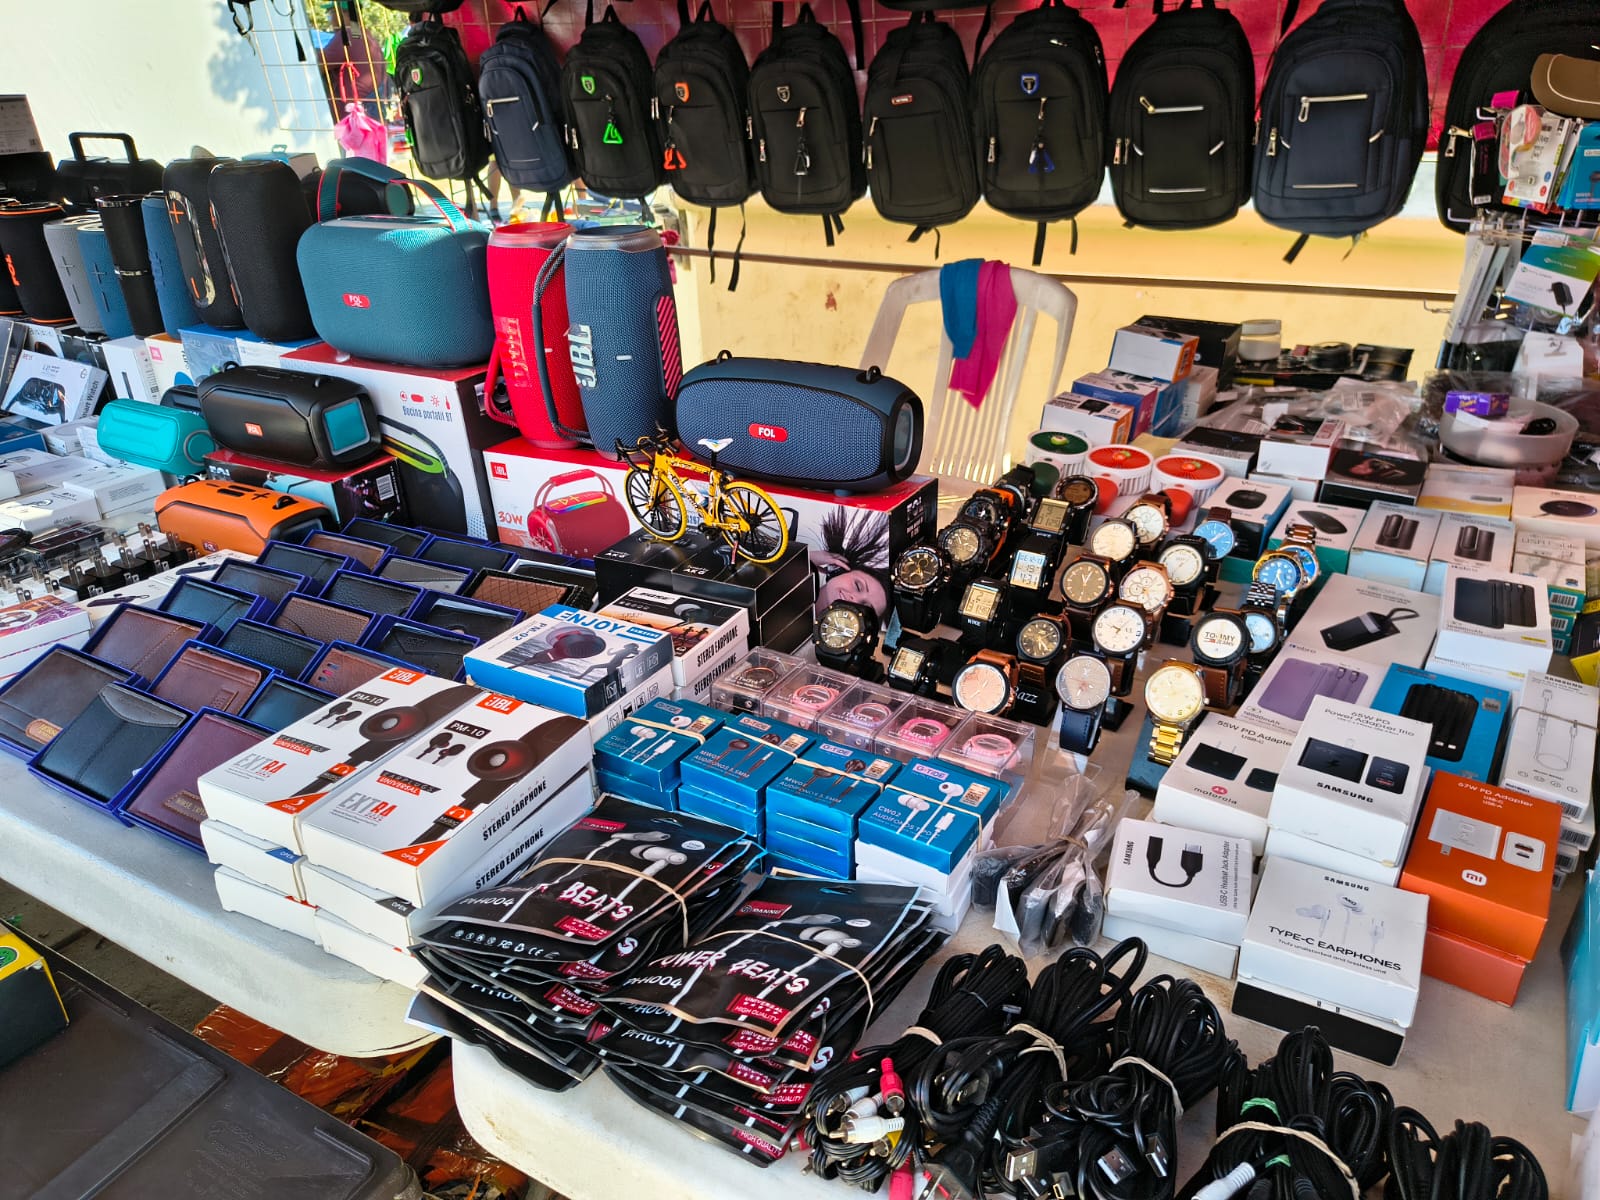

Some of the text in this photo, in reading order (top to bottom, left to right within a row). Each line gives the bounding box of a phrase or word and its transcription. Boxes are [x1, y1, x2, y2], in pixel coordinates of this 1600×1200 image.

[564, 323, 598, 389] JBL
[758, 426, 776, 438] FOL
[497, 511, 523, 526] 30W
[556, 611, 625, 635] ENJOY
[714, 625, 739, 654] EARPHONE
[351, 692, 384, 706] PM-10
[484, 697, 512, 713] JBL
[450, 722, 486, 738] PM-10
[1240, 727, 1257, 737] PD
[379, 776, 420, 796] UNIVERSAL
[1193, 786, 1238, 805] motorola
[1316, 781, 1374, 804] SAMSUNG
[337, 792, 398, 817] EXTRA
[482, 779, 547, 843] STEREO EARPHONE
[475, 827, 545, 890] STEREO EARPHONE
[1323, 875, 1370, 892] SAMSUNG
[558, 880, 634, 922] BEATS
[1268, 925, 1402, 971] TYPE-C EARPHONES
[727, 958, 810, 996] BEATS
[734, 1006, 780, 1022] HIGH QUALITY
[740, 1129, 757, 1143] HIGH
